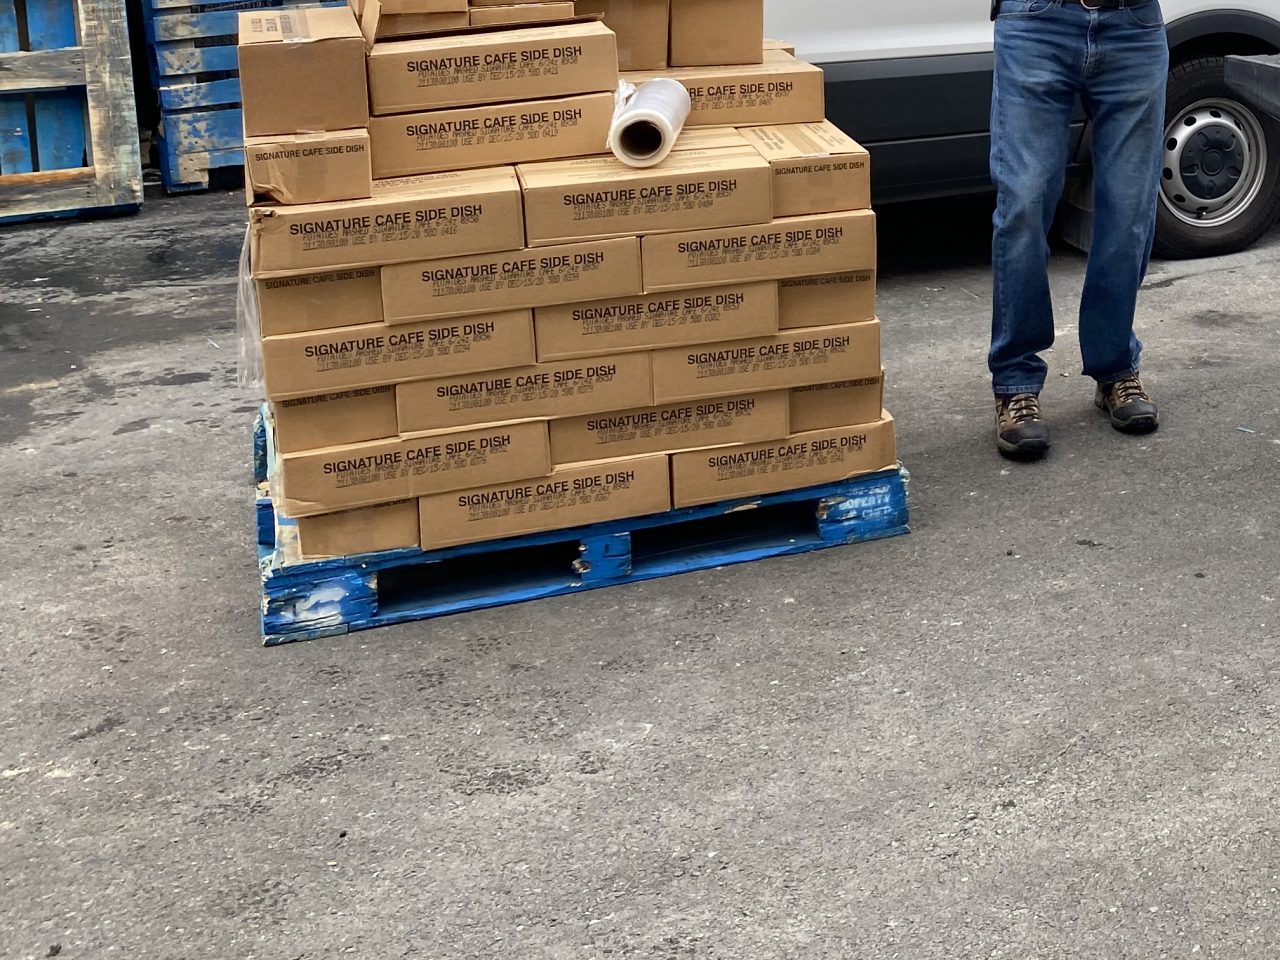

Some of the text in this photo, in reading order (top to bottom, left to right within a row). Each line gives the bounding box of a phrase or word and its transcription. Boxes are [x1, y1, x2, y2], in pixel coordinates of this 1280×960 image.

[407, 46, 581, 72] SIGNATURE CAFE SIDE DISH
[708, 85, 736, 96] CAFE
[740, 83, 764, 93] SIDE
[768, 81, 793, 91] DISH
[406, 109, 581, 136] SIGNATURE CAFE SIDE DISH
[256, 144, 364, 161] SIGNATURE CAFE SIDE DISH
[775, 166, 812, 175] SIGNATURE
[814, 164, 831, 172] CAFE
[564, 180, 736, 205] SIGNATURE CAFE SIDE DISH
[290, 205, 482, 235] SIGNATURE CAFE SIDE DISH
[678, 227, 842, 253] SIGNATURE CAFE SIDE DISH
[266, 270, 374, 289] SIGNATURE CAFE SIDE DISH
[422, 252, 603, 282] SIGNATURE CAFE SIDE DISH
[572, 293, 743, 320] SIGNATURE CAFE SIDE DISH
[305, 322, 494, 357] SIGNATURE CAFE SIDE DISH
[688, 336, 850, 365] SIGNATURE CAFE SIDE DISH
[437, 365, 616, 398] SIGNATURE CAFE SIDE DISH
[587, 399, 755, 430] SIGNATURE CAFE SIDE DISH
[323, 435, 511, 474] SIGNATURE CAFE SIDE DISH
[709, 434, 866, 467] SIGNATURE CAFE SIDE DISH
[458, 471, 634, 507] SIGNATURE CAFE SIDE DISH
